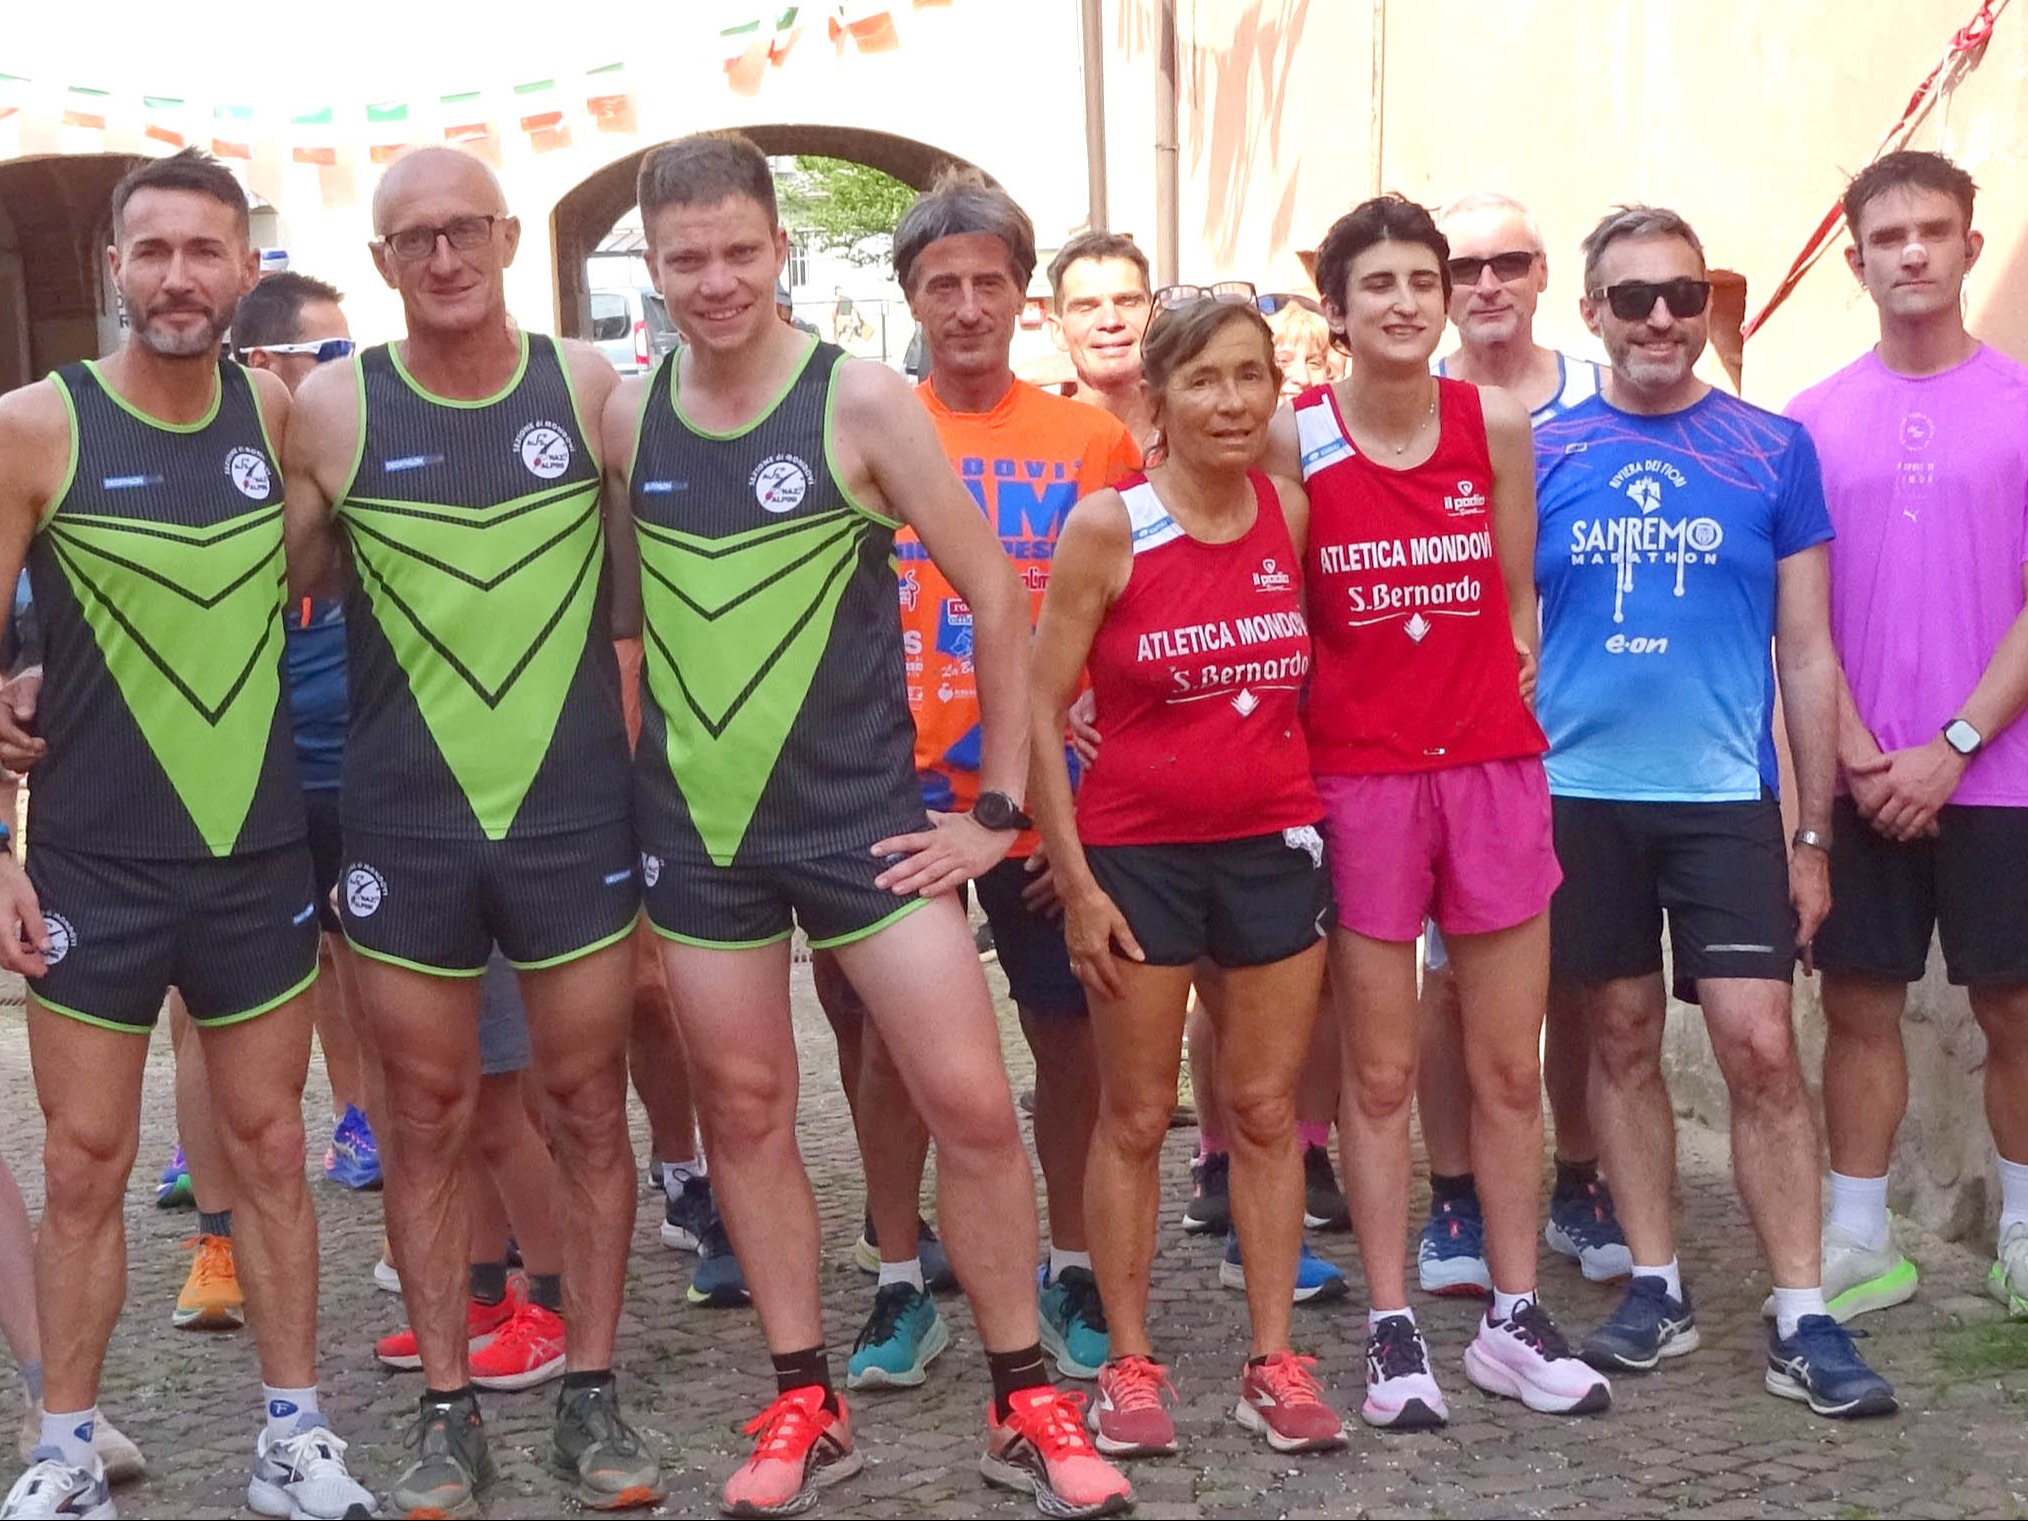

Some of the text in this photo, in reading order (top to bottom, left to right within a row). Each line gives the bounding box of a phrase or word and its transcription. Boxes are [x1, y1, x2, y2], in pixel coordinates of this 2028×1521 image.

[1609, 461, 1643, 489] RIVIERA
[1660, 462, 1687, 488] FIORI
[1571, 516, 1723, 551] SANREMO
[1320, 540, 1407, 575] ATLETICA
[1571, 552, 1718, 566] MARATHON
[1137, 621, 1235, 662] ATLETICA
